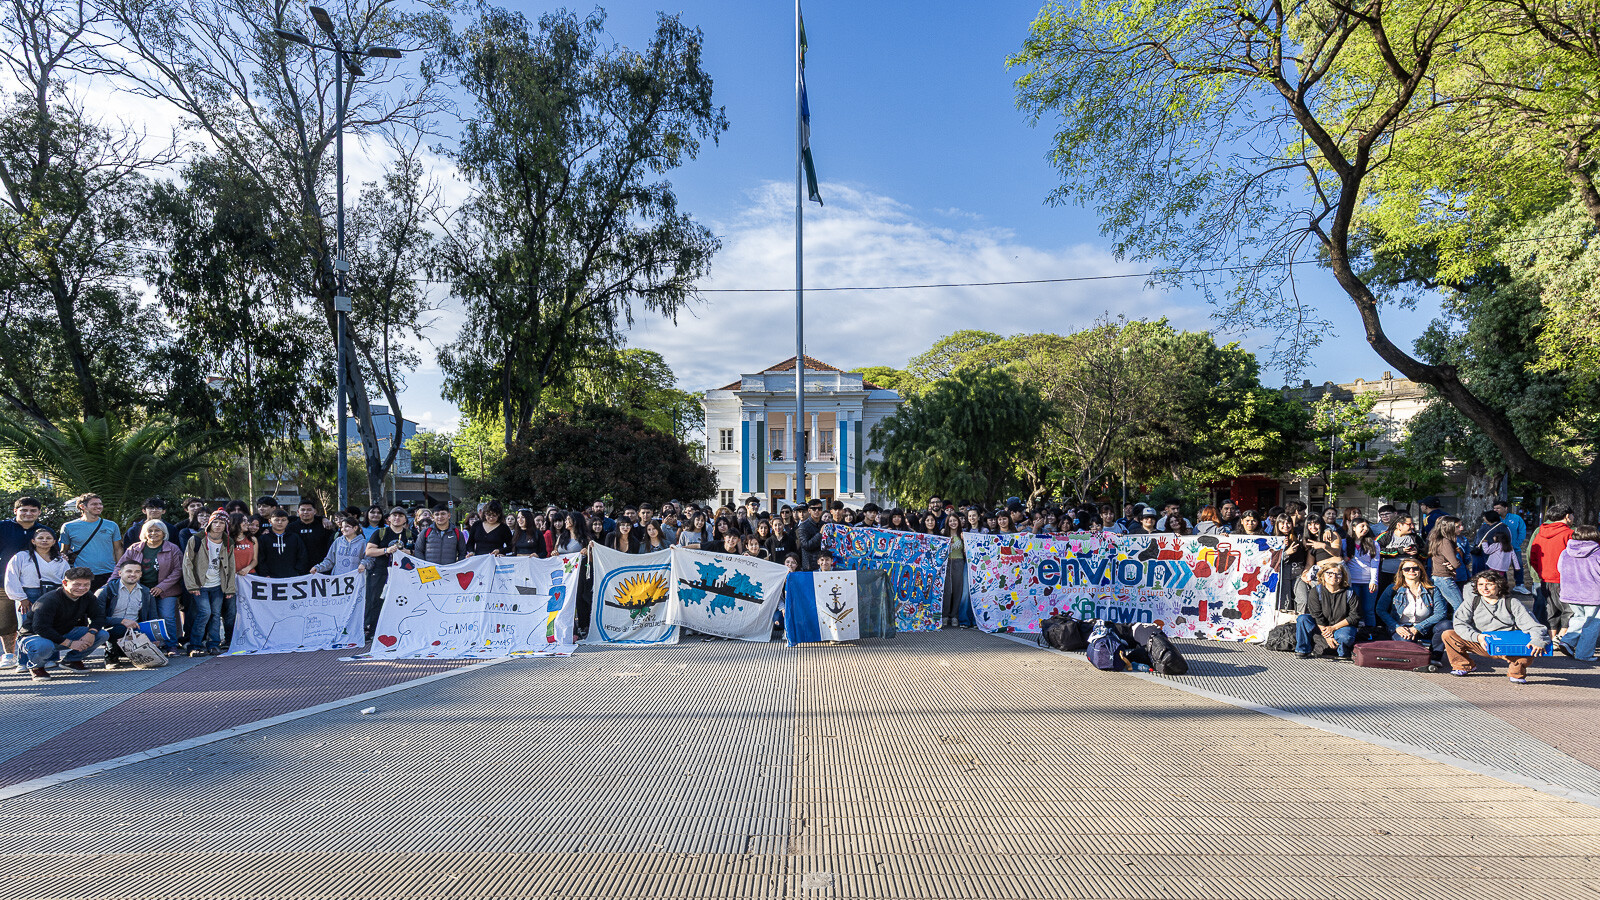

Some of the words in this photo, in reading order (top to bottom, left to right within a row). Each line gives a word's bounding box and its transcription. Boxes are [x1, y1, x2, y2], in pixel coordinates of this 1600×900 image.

[1061, 585, 1116, 595] oportunidad
[1119, 586, 1131, 595] de
[1137, 588, 1164, 598] futuro
[1080, 600, 1153, 624] Brown
